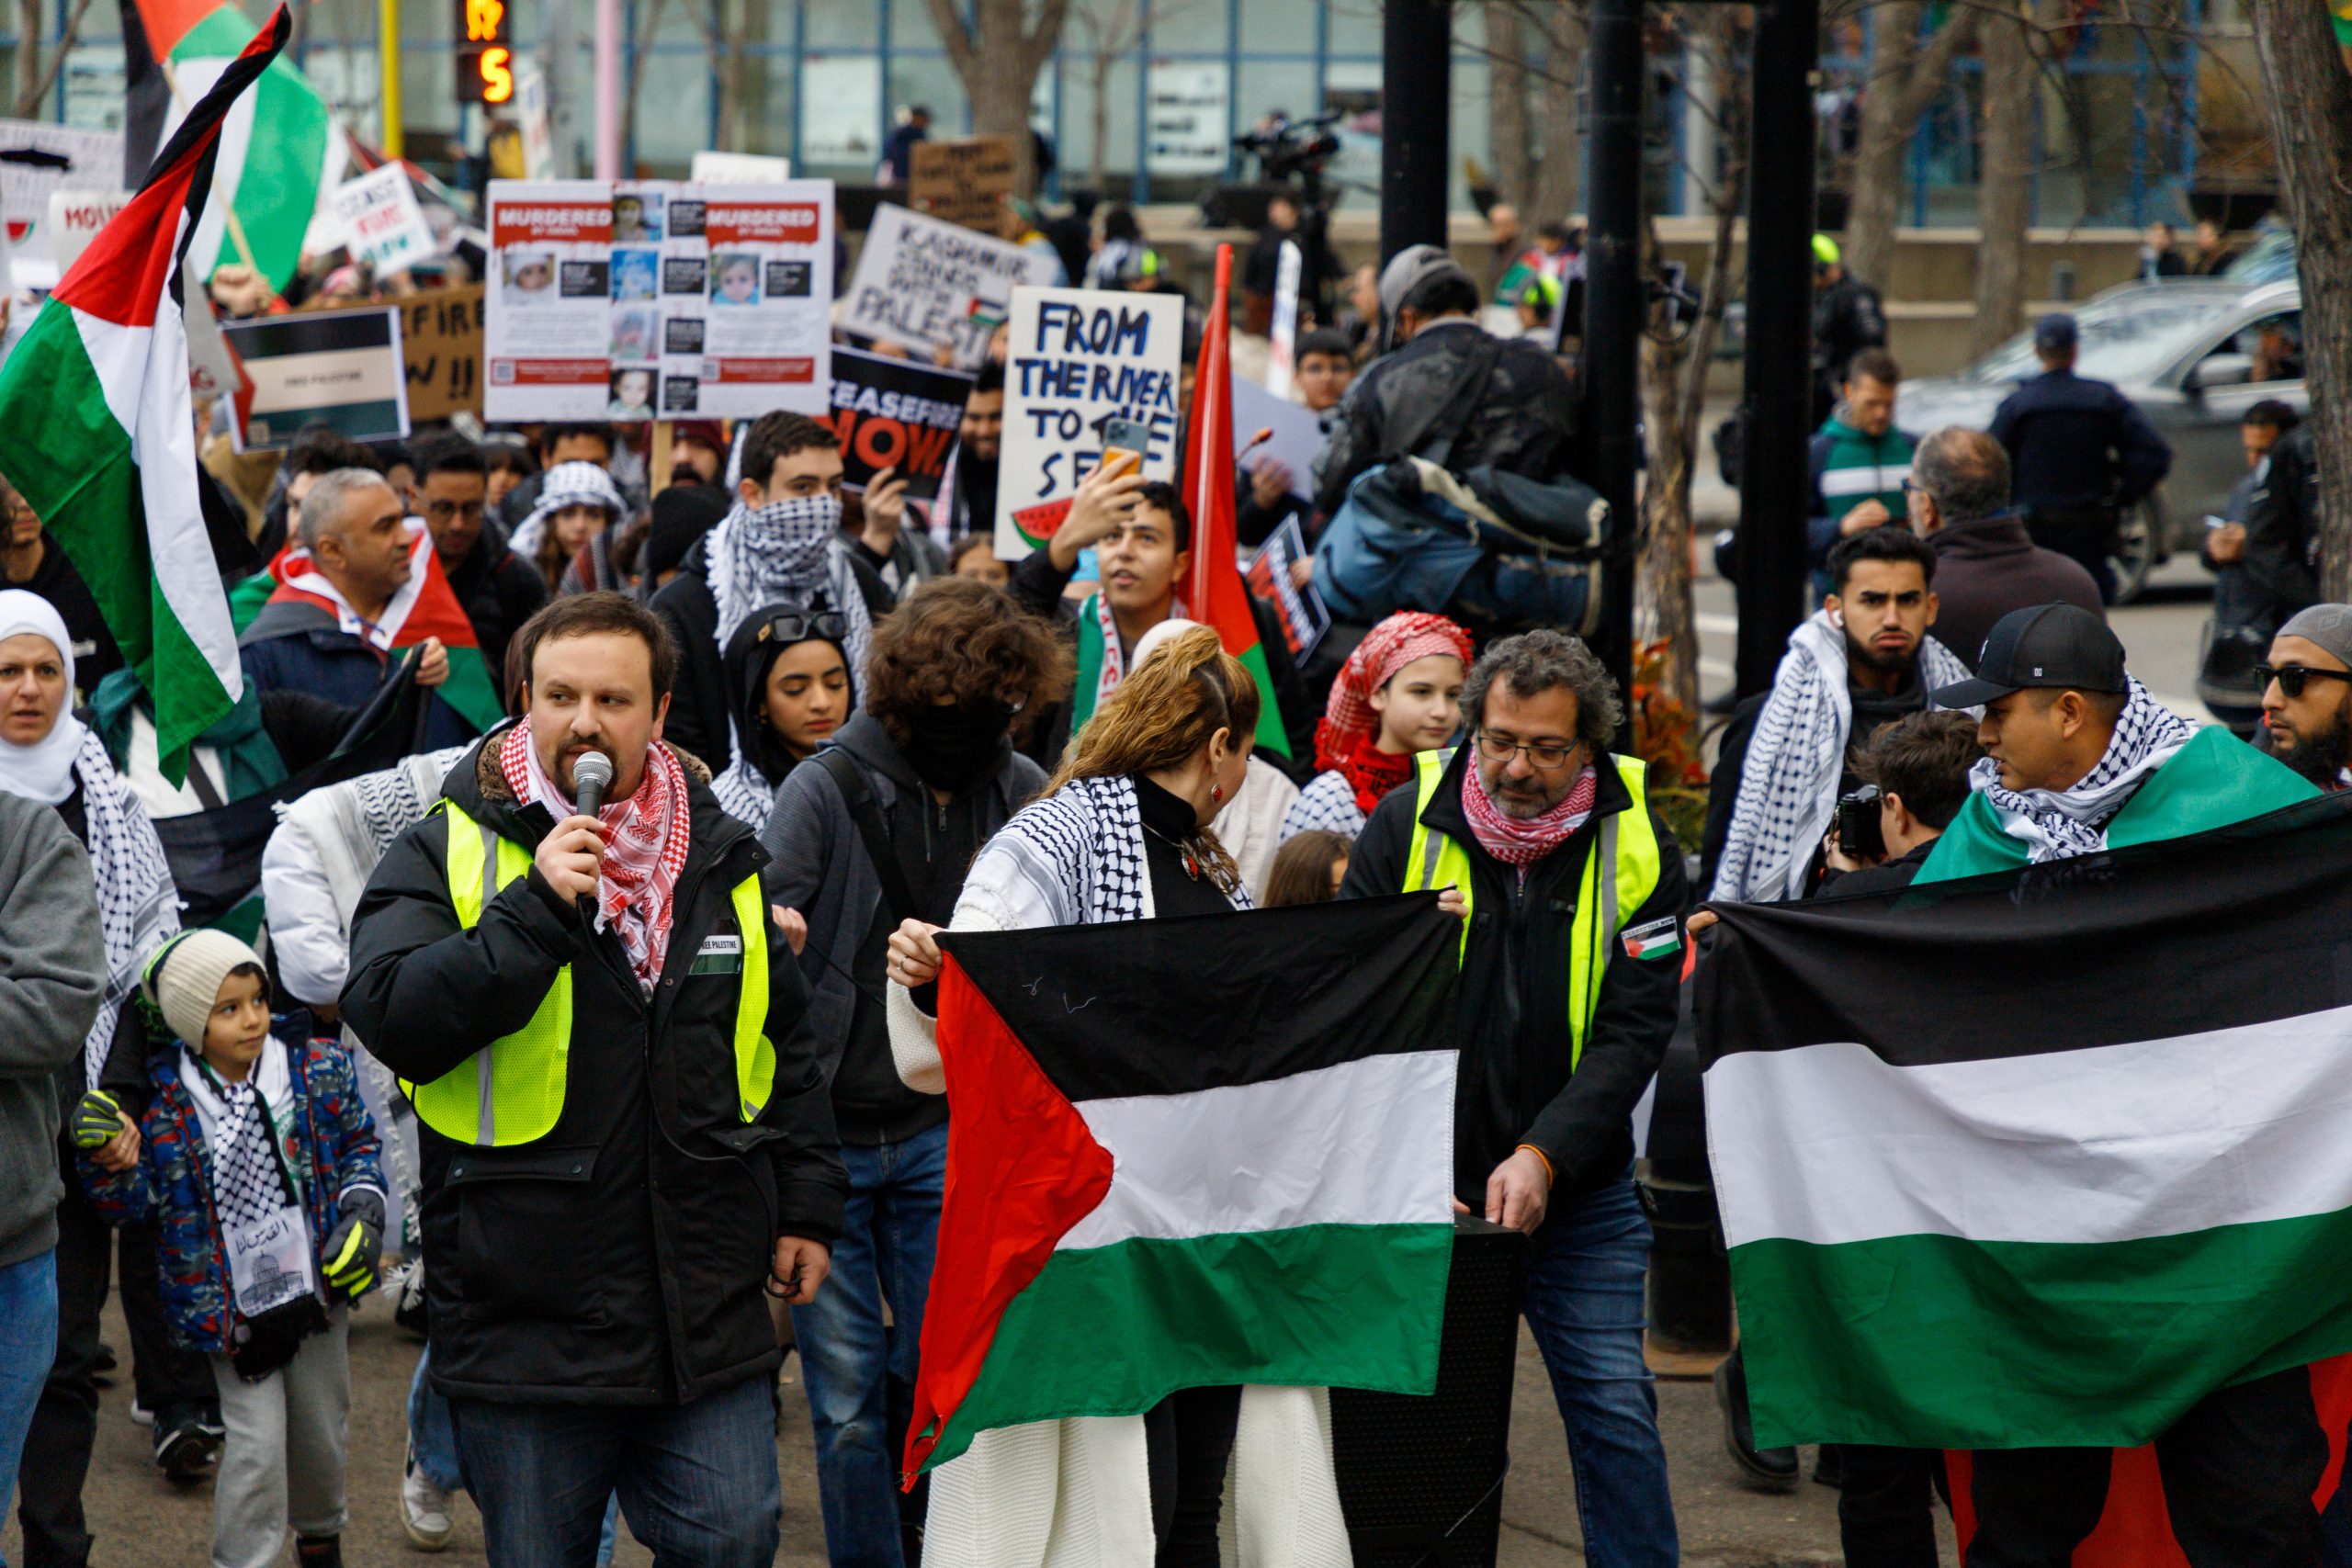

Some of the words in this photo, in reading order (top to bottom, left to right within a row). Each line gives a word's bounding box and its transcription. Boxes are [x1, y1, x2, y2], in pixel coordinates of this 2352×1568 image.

[481, 47, 513, 102] 5
[498, 208, 613, 227] MURDERED
[707, 209, 816, 228] MURDERED
[899, 222, 1031, 282] KASHMIR
[1036, 300, 1150, 356] FROM
[1014, 358, 1088, 398] THE
[1090, 364, 1174, 412] RIVER
[1026, 408, 1082, 441] TO
[1037, 452, 1102, 499] SE
[712, 941, 737, 950] PALESTINE
